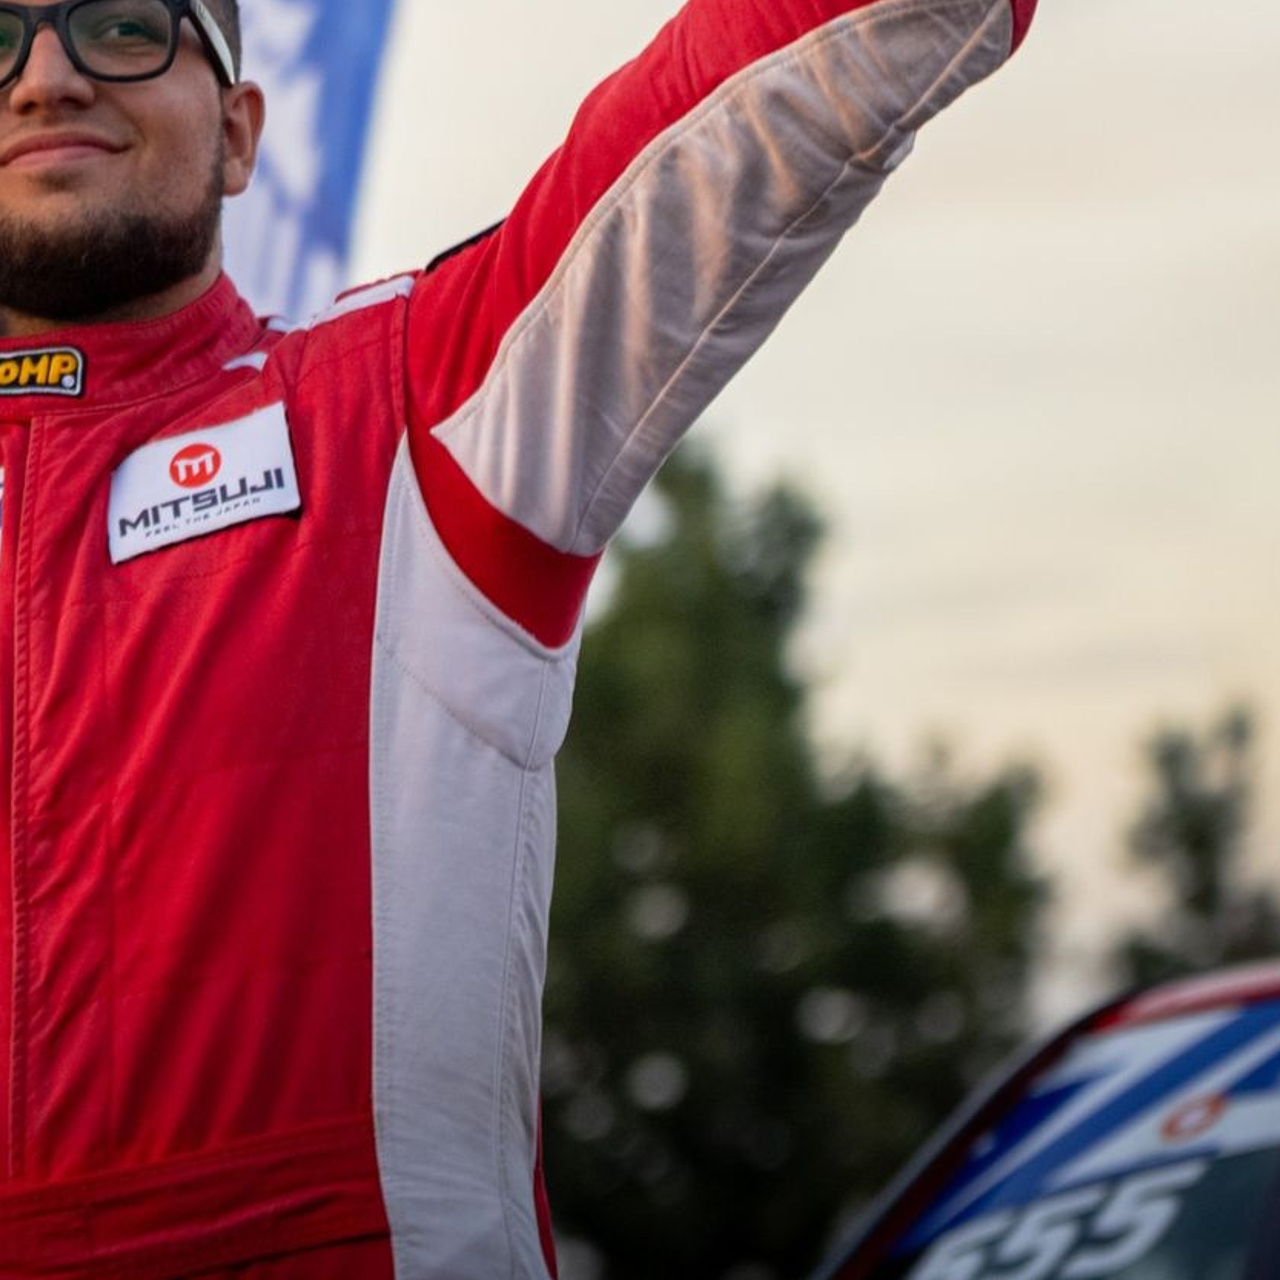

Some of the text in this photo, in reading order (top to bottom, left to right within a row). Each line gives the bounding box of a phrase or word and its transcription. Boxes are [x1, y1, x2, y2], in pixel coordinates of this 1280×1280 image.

[119, 468, 284, 537] MITSUJI
[186, 513, 211, 526] THE
[216, 496, 262, 516] JAPAN
